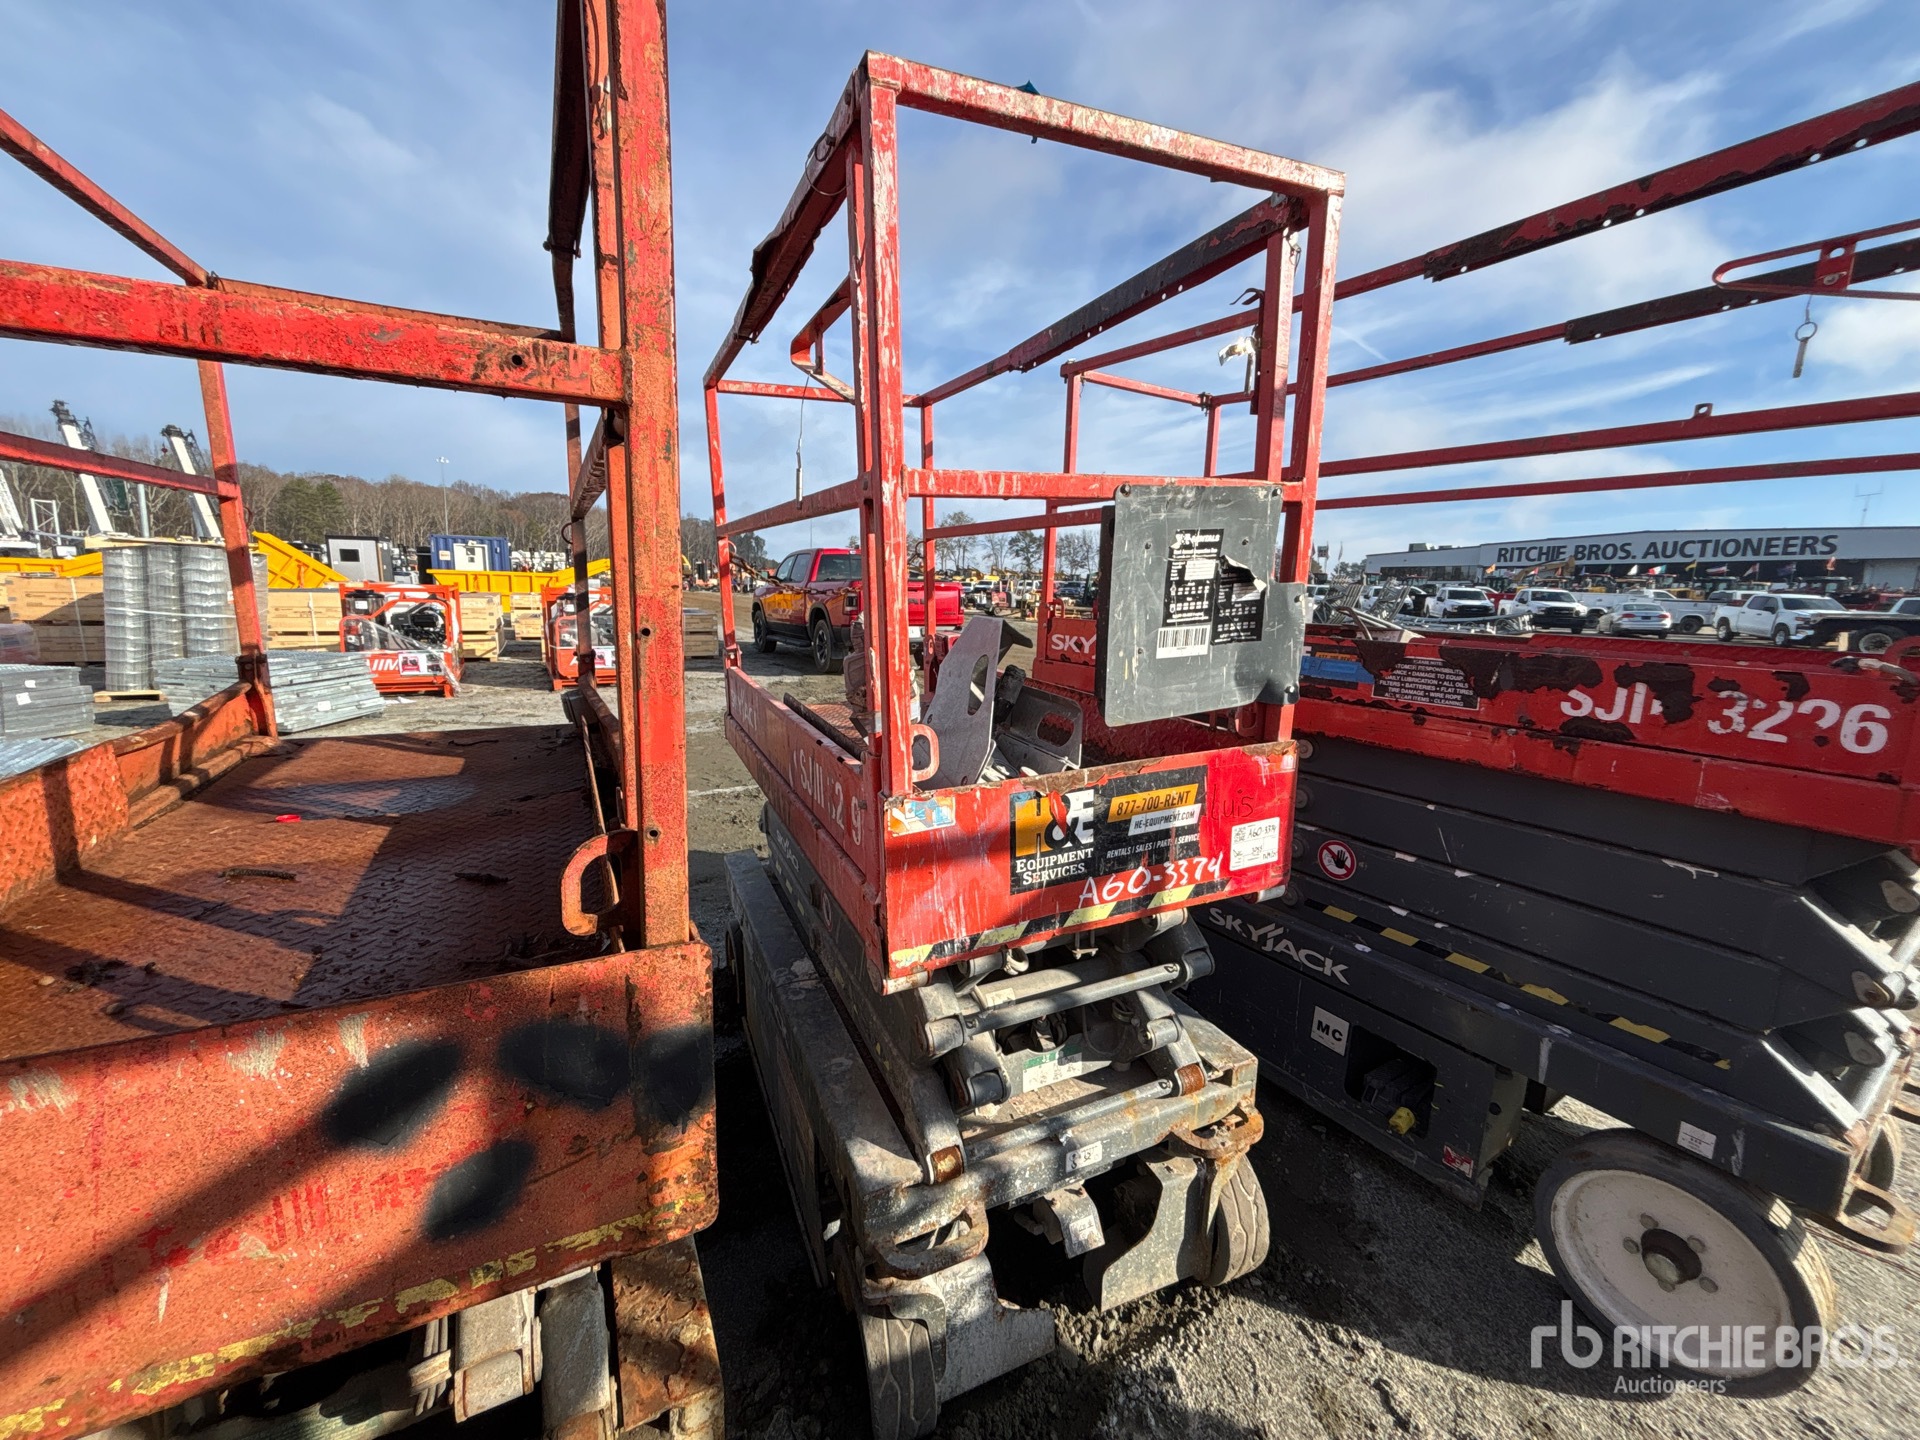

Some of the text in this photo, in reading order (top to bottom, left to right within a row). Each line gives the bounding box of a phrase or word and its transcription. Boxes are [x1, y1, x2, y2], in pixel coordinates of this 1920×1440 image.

[1497, 535, 1838, 562] RITCHIE BROS. AUCTIONEERS
[1051, 633, 1097, 655] SKY
[1401, 675, 1438, 685] LUBRICATION
[1412, 671, 1436, 679] DAMAGE
[1405, 683, 1436, 691] BATTERIES
[1116, 791, 1191, 816] 877-700-RENT
[1134, 810, 1196, 829] HE-EQUIPMENT.COM
[1106, 846, 1131, 859] RENTALS
[1135, 842, 1153, 853] SALES
[1178, 832, 1200, 845] SERVICE
[1015, 848, 1094, 873] EQUIPMENT
[1022, 862, 1085, 885] SERVICES
[1078, 851, 1224, 909] A60-3374
[1208, 907, 1350, 985] SKYJACK
[1317, 1019, 1343, 1042] MC
